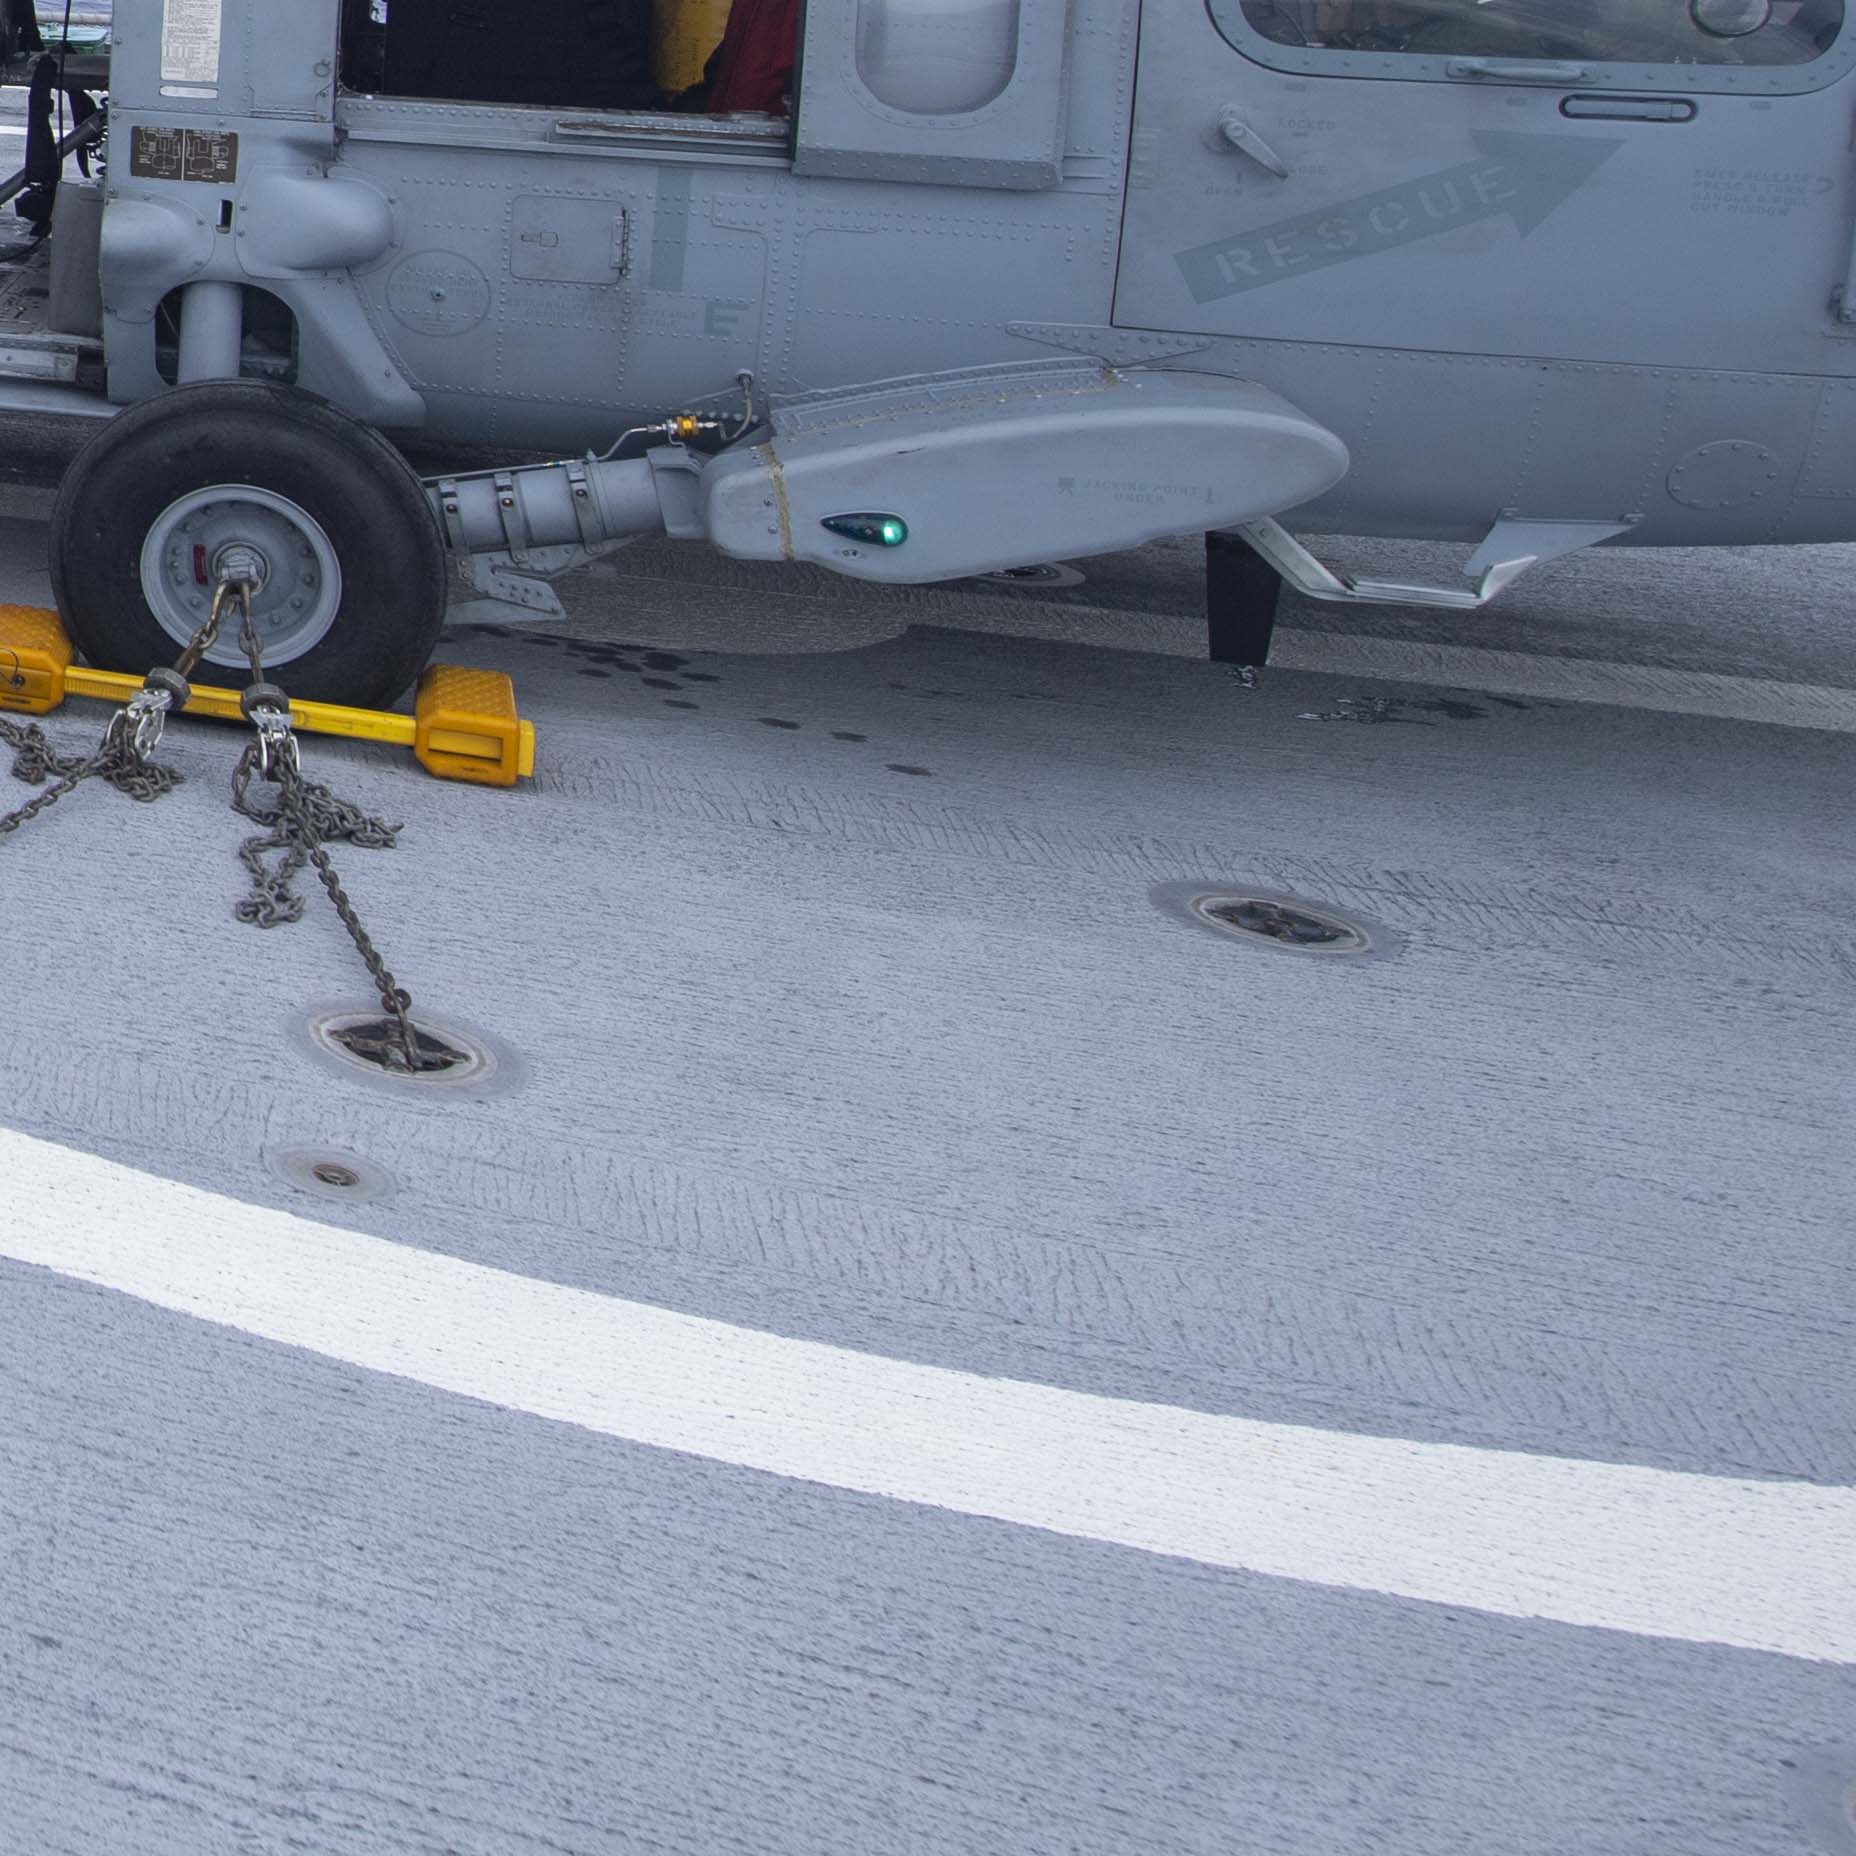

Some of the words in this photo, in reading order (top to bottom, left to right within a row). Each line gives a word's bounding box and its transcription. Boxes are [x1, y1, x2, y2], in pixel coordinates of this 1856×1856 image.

[1215, 163, 1519, 285] RESCUE
[704, 300, 750, 337] E
[1113, 491, 1166, 505] UNDER
[1153, 484, 1201, 497] POINT
